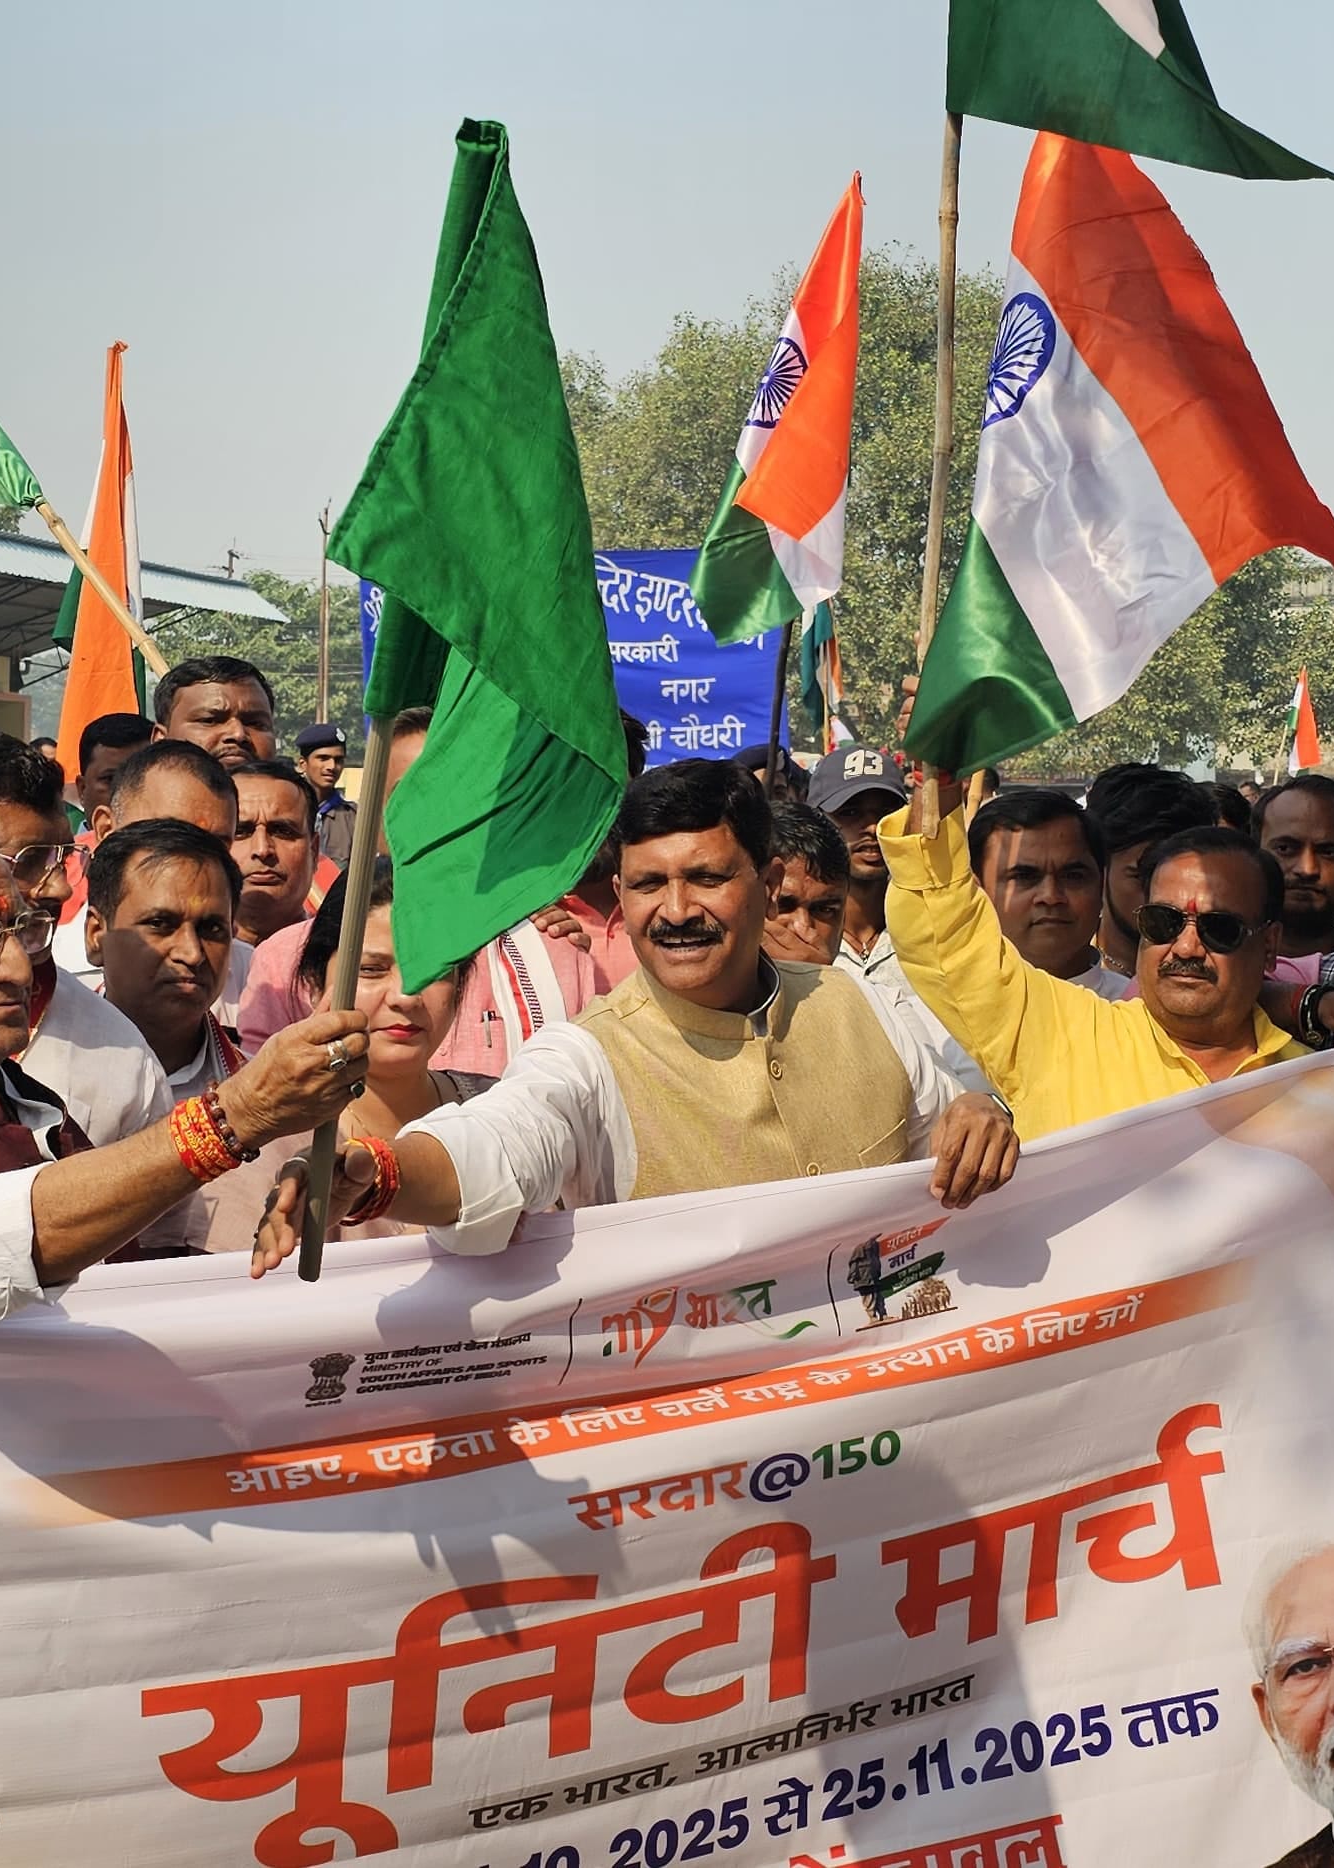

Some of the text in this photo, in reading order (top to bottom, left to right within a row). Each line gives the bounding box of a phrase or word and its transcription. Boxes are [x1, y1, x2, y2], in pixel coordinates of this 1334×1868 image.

[660, 677, 716, 704] नगर
[670, 714, 746, 750] चौधरी
[844, 749, 883, 780] 93
[356, 1375, 452, 1394] GOVERNMENT
[456, 1372, 474, 1382] OF
[359, 1355, 548, 1384] YOUTH AFFAIRS AND SPORTS
[362, 1357, 443, 1373] MINISTRY OF
[225, 1454, 359, 1493] आइए,
[368, 1430, 496, 1473] एकता
[505, 1416, 551, 1447] के
[558, 1405, 647, 1438] लिए
[653, 1385, 729, 1418] चलें
[807, 1363, 852, 1386] के
[856, 1338, 970, 1378] उत्थान
[975, 1325, 1019, 1355] के
[1021, 1312, 1089, 1345] लिए
[1094, 1292, 1147, 1329] जगें
[568, 1429, 901, 1534] सरदार@150
[141, 1403, 1225, 1868] यूनिटी मार्च
[469, 1673, 975, 1829] एक भारत, आत्मनिर्भर भारत
[763, 1777, 815, 1836] से
[822, 1704, 1113, 1821] 25.11.2025
[1122, 1688, 1220, 1749] तक
